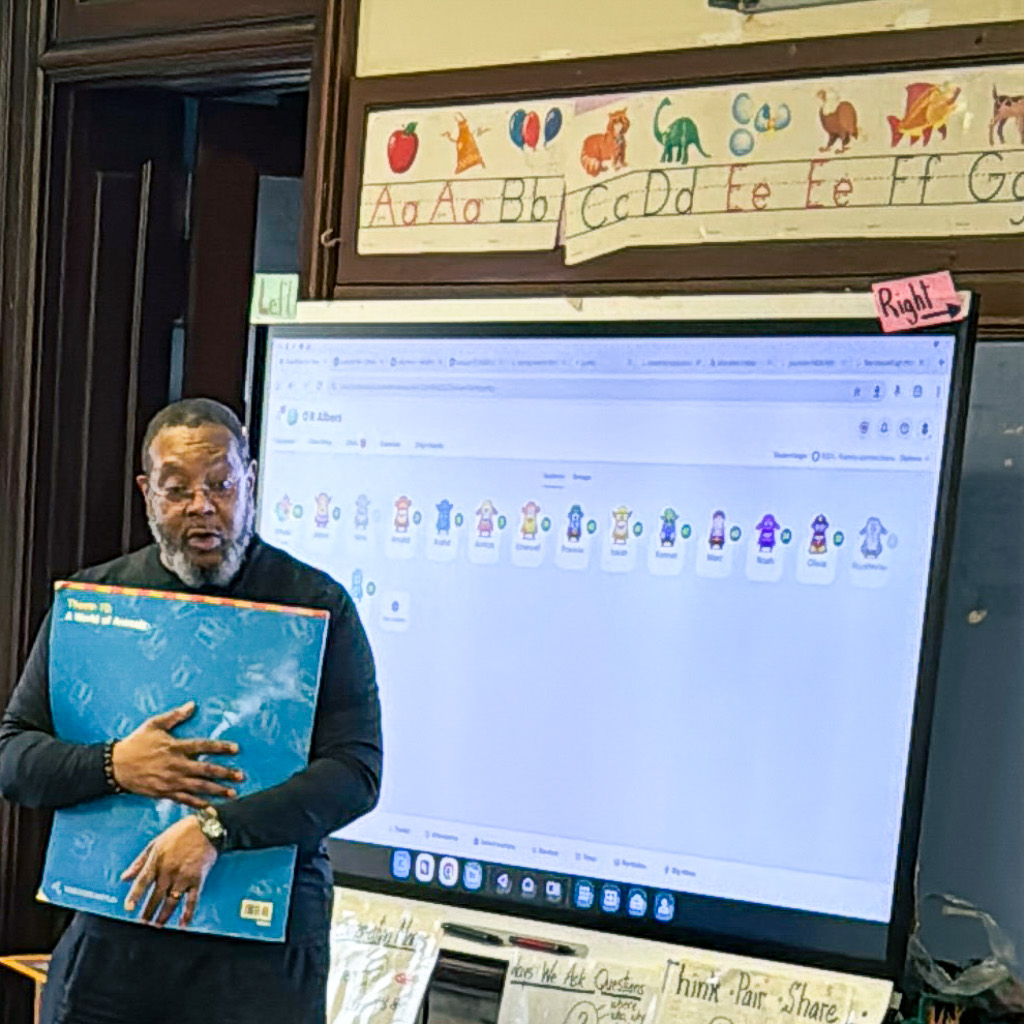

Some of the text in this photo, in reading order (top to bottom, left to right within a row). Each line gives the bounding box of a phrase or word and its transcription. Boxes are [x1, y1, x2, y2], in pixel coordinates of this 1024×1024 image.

[370, 184, 418, 227] Aa
[430, 181, 482, 224] Aa
[500, 178, 548, 222] Bb
[581, 184, 630, 229] Cc
[644, 168, 697, 216] Dd
[727, 164, 771, 212] Ee
[806, 158, 853, 209] Ee
[889, 154, 942, 206] Ff
[877, 280, 934, 324] Right
[662, 958, 721, 1004] Think
[782, 980, 840, 1024] Share
